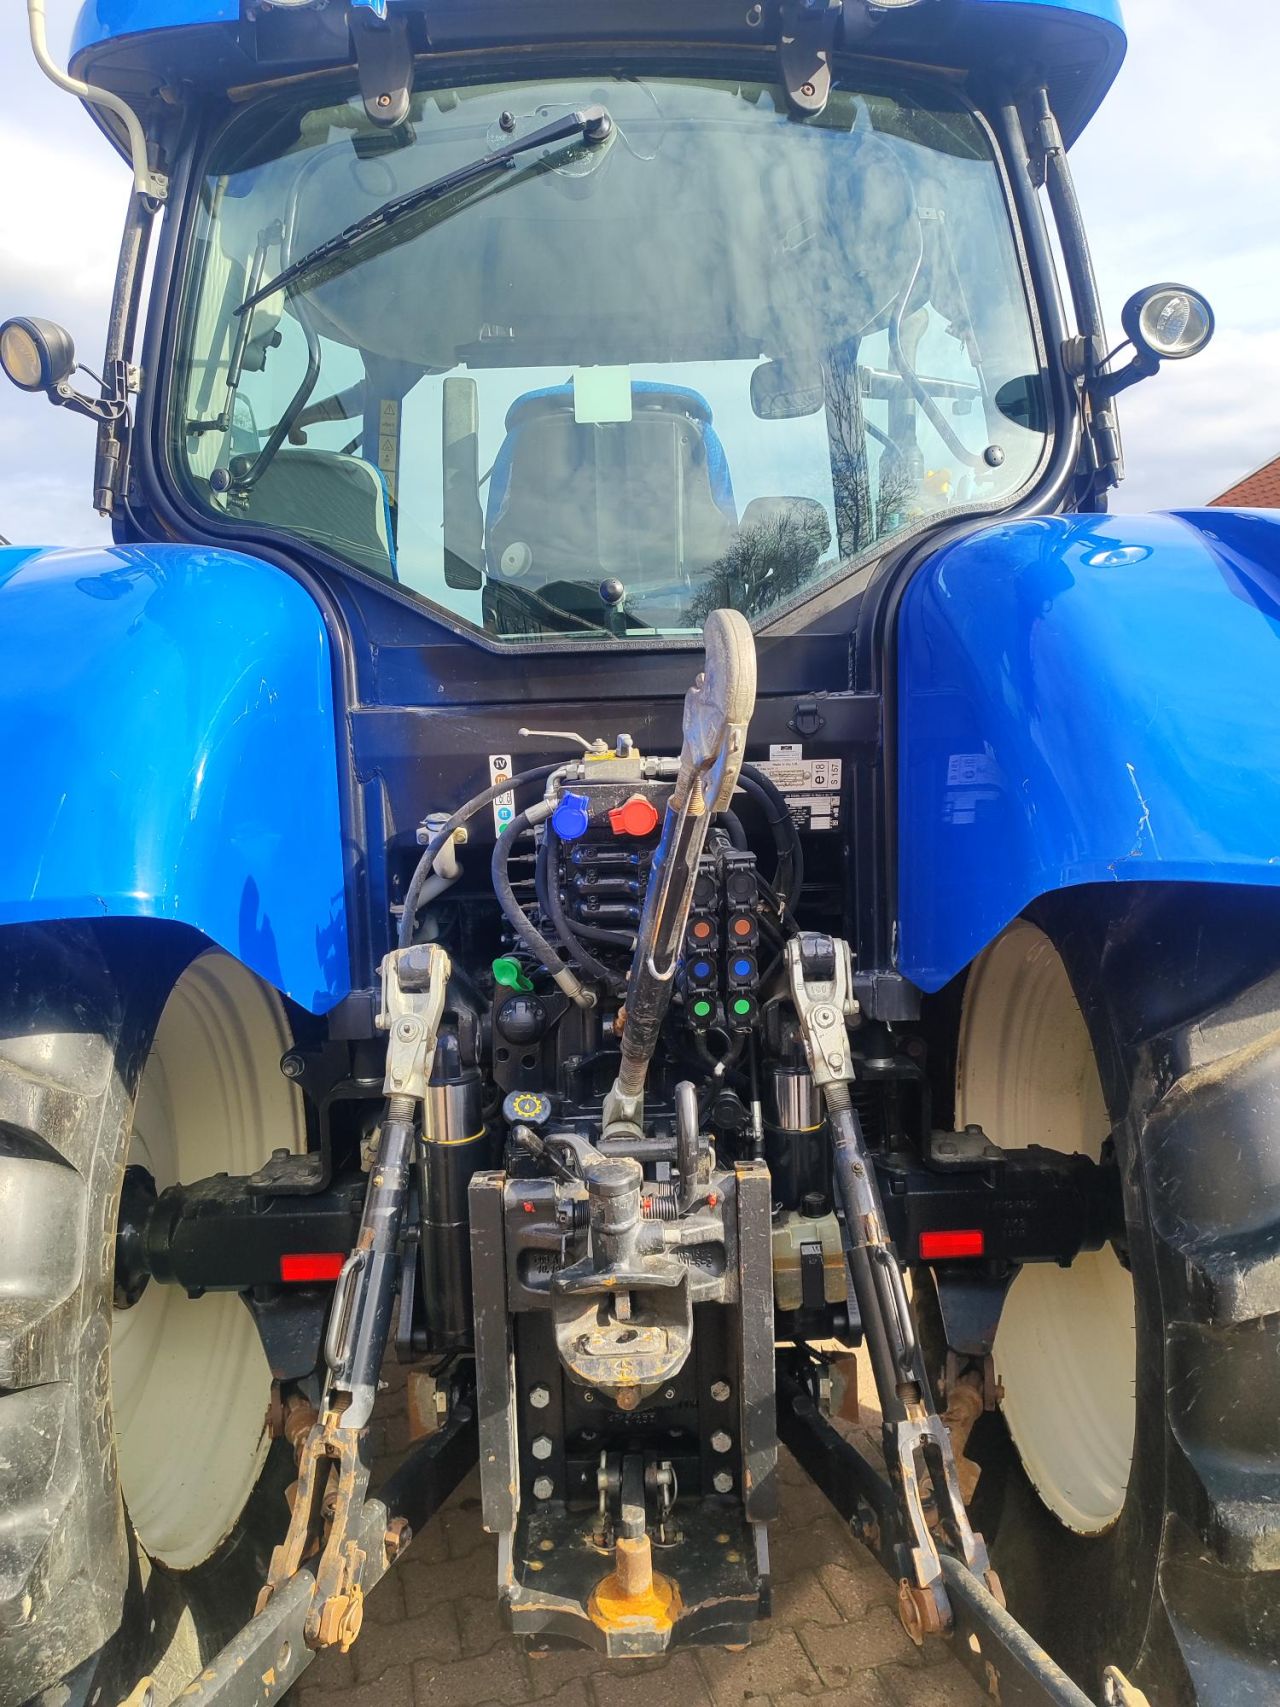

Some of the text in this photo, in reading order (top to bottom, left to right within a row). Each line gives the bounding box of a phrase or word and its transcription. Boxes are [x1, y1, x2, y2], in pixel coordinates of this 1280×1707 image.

[815, 764, 825, 784] e 18
[831, 764, 839, 777] 157
